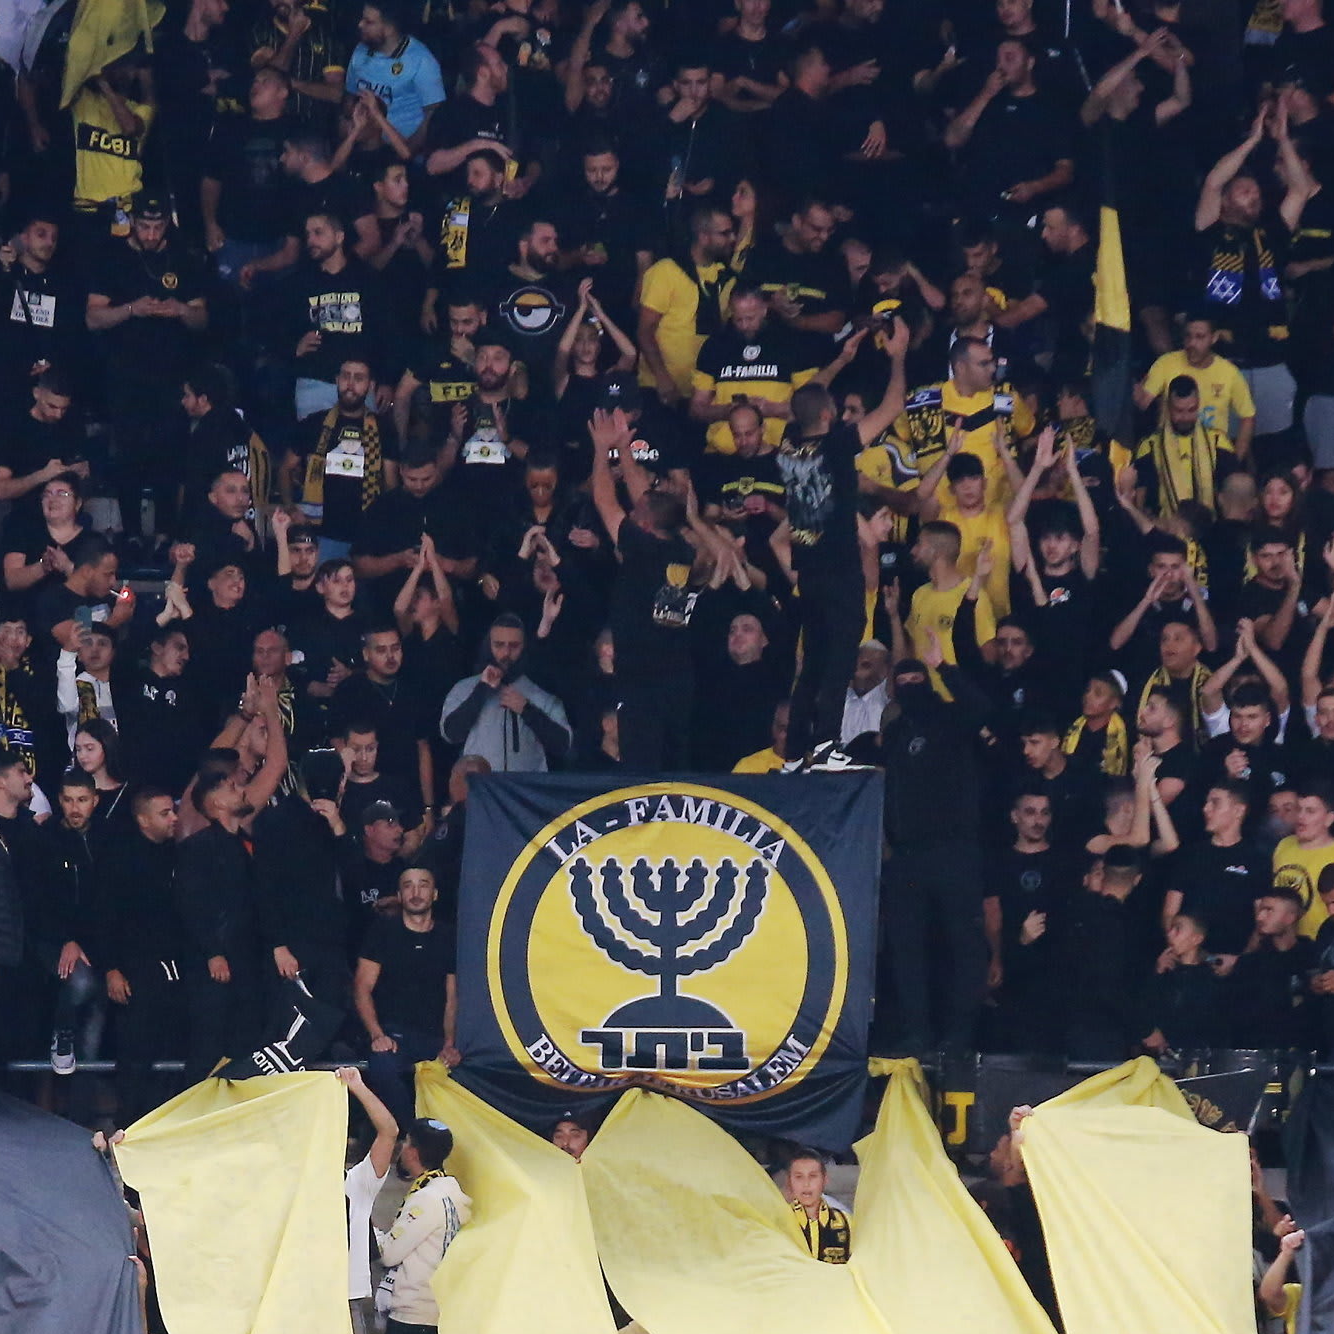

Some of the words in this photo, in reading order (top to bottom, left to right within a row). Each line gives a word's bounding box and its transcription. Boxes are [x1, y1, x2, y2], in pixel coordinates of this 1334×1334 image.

[89, 131, 131, 156] FCBJ
[546, 820, 602, 865] LA
[624, 794, 787, 868] FAMILIA
[579, 1027, 751, 1072] ביתר
